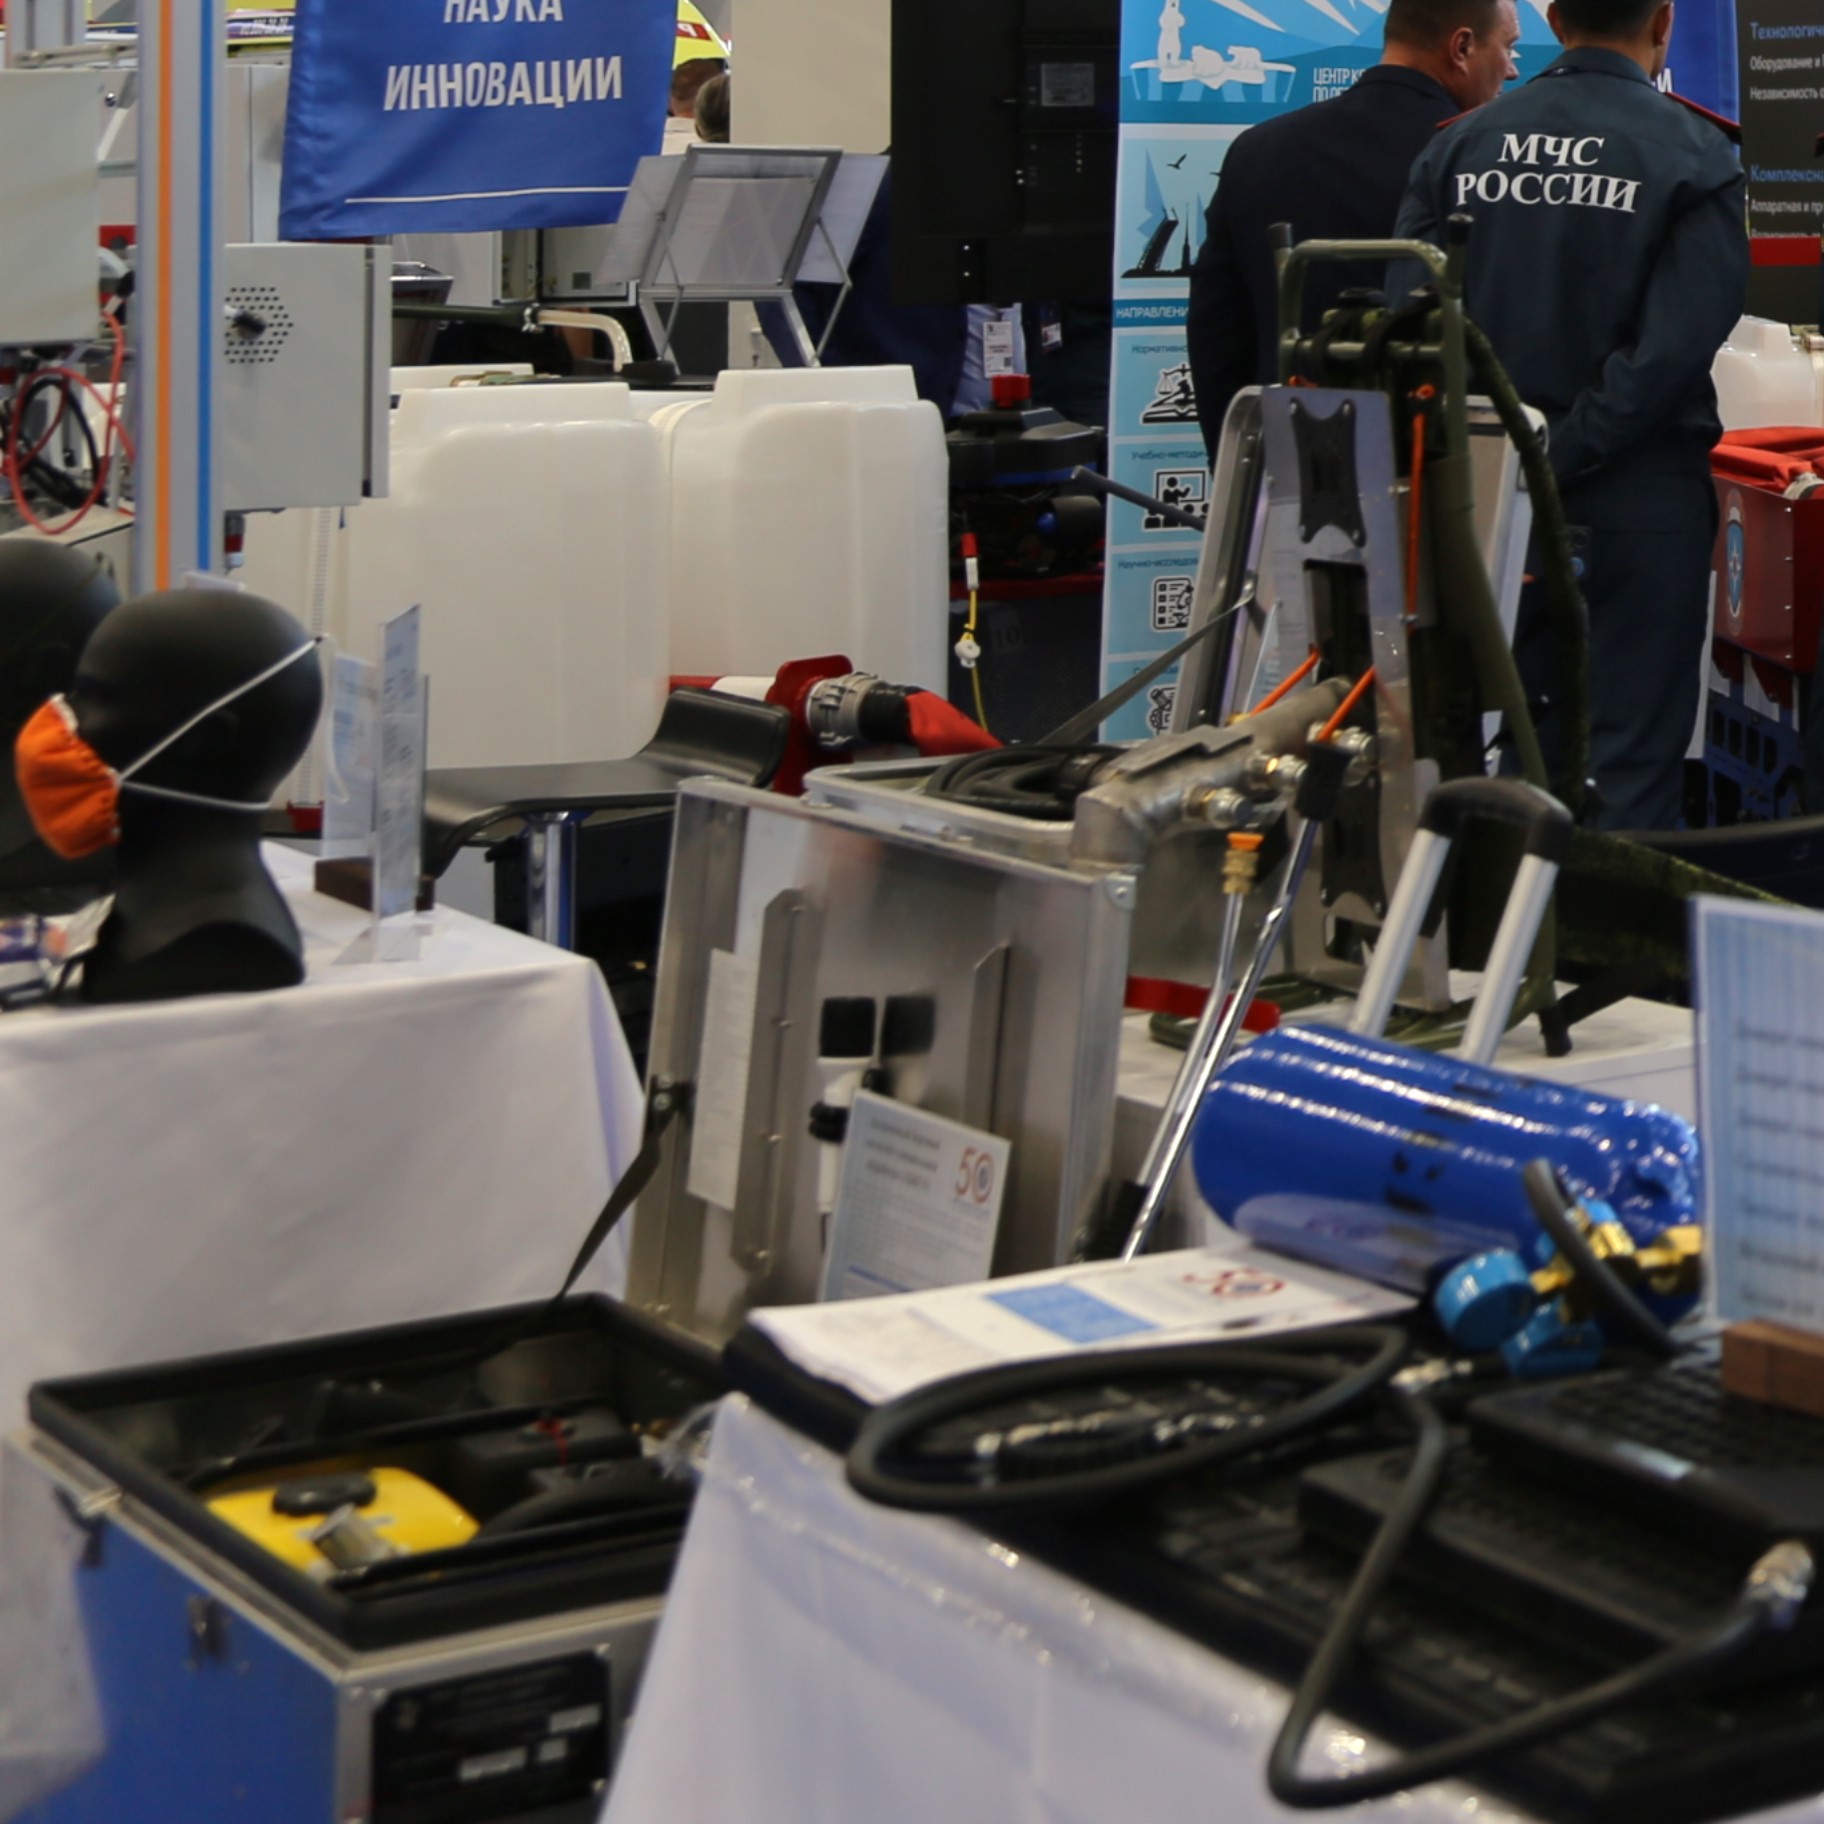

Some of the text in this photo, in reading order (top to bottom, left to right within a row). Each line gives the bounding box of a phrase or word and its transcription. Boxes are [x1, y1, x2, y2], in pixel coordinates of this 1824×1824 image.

[1314, 68, 1350, 85] ЦЕНТР
[1750, 55, 1813, 73] Оборудование
[383, 55, 623, 111] ИННОВАЦИИ
[1750, 86, 1818, 101] Независимость
[1497, 133, 1606, 167] МЧС
[1455, 169, 1642, 213] РОССИИ
